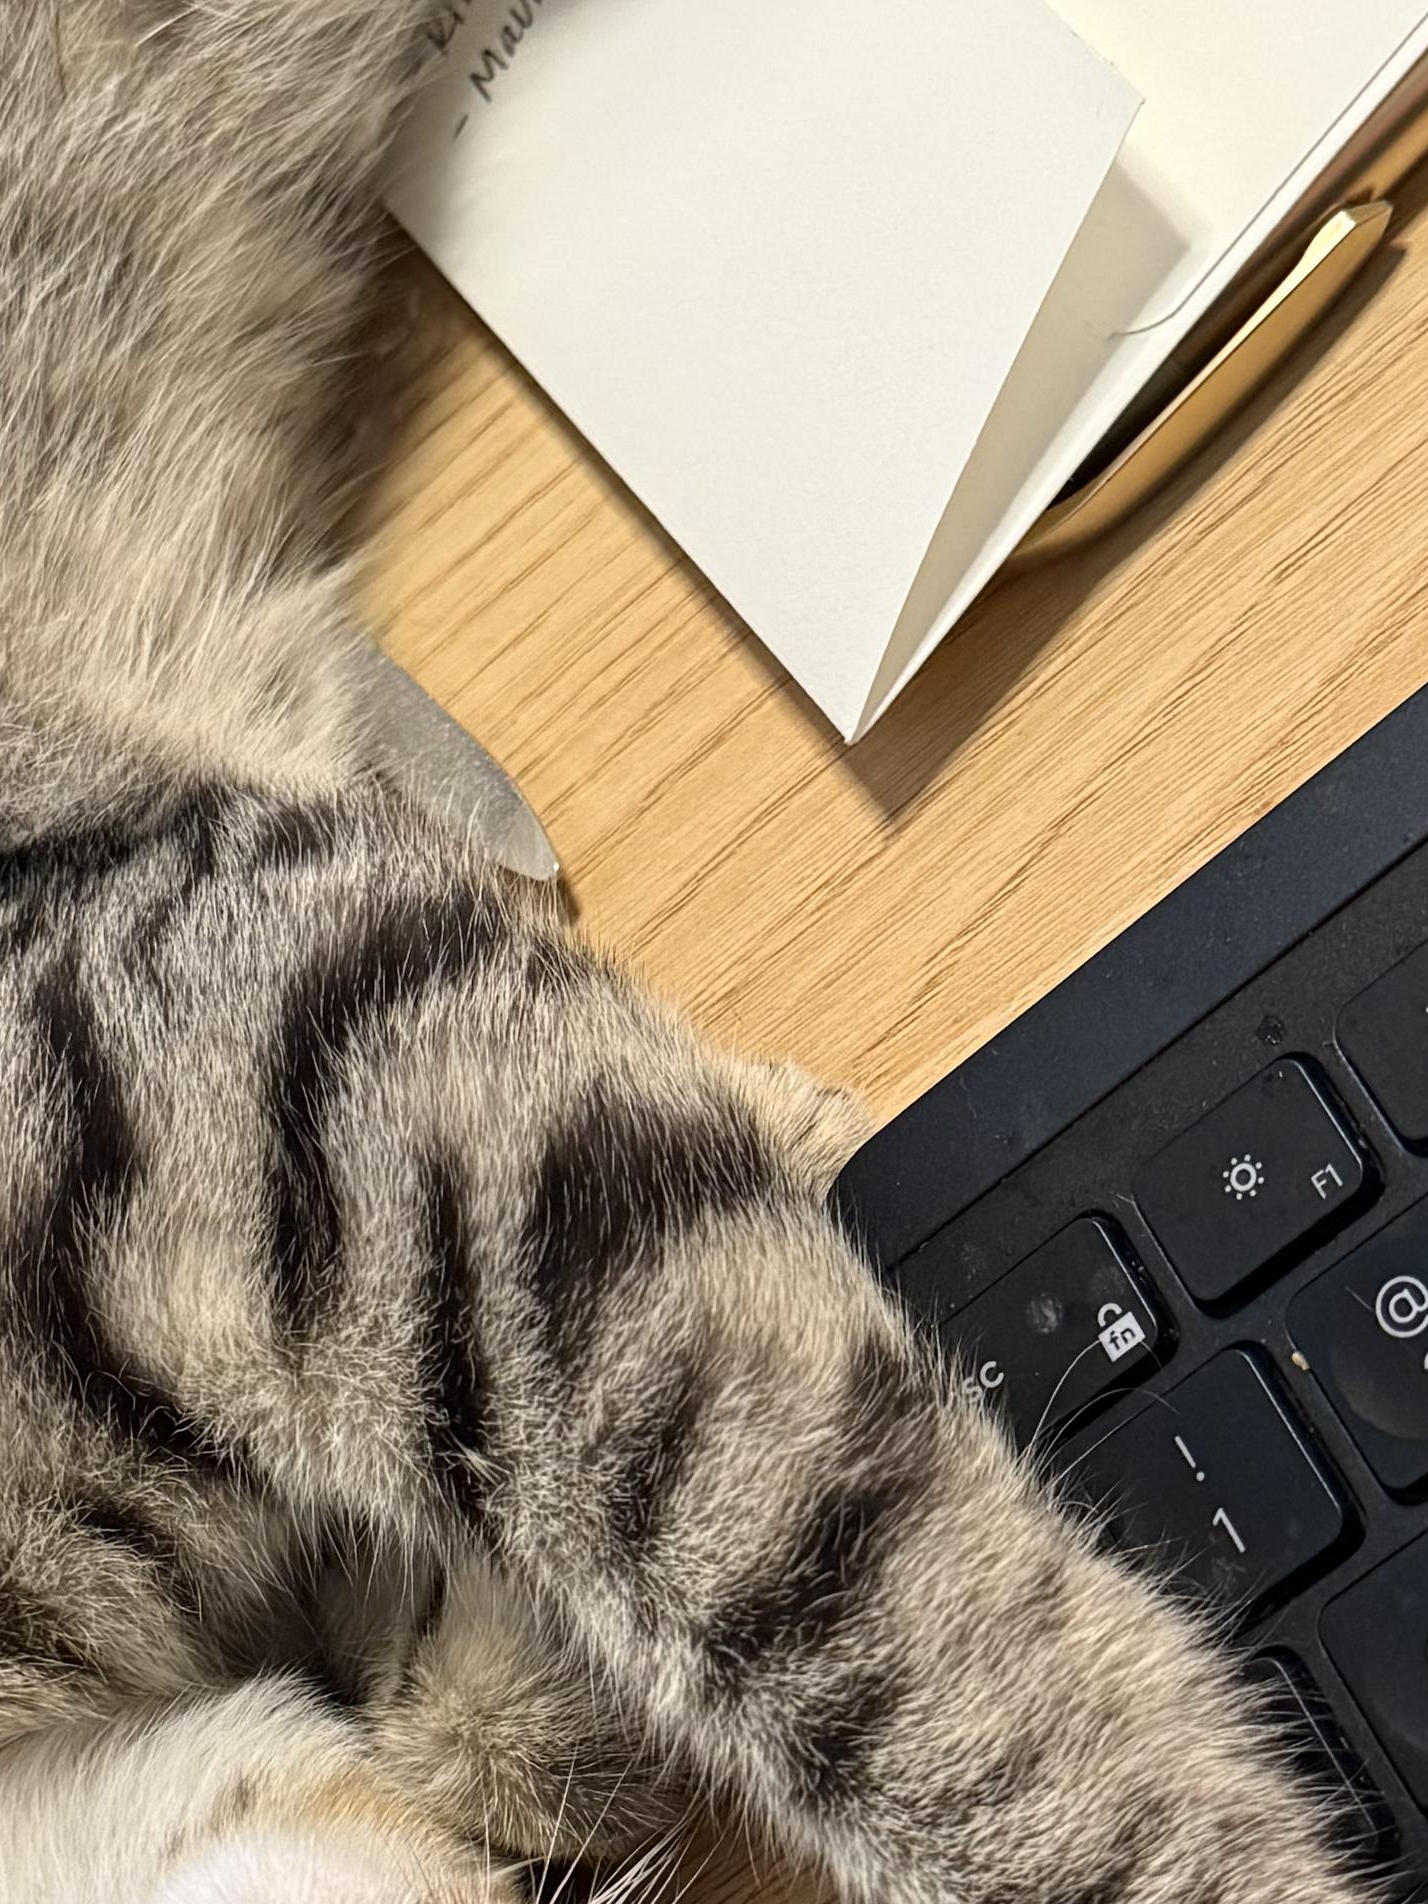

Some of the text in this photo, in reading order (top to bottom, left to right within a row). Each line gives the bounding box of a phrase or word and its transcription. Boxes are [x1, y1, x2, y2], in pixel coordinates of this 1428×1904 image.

[1311, 1164, 1343, 1199] F1
[1109, 1327, 1136, 1350] fn
[962, 1361, 1004, 1402] sc
[1175, 1436, 1204, 1481] !
[1213, 1508, 1245, 1552] 1
